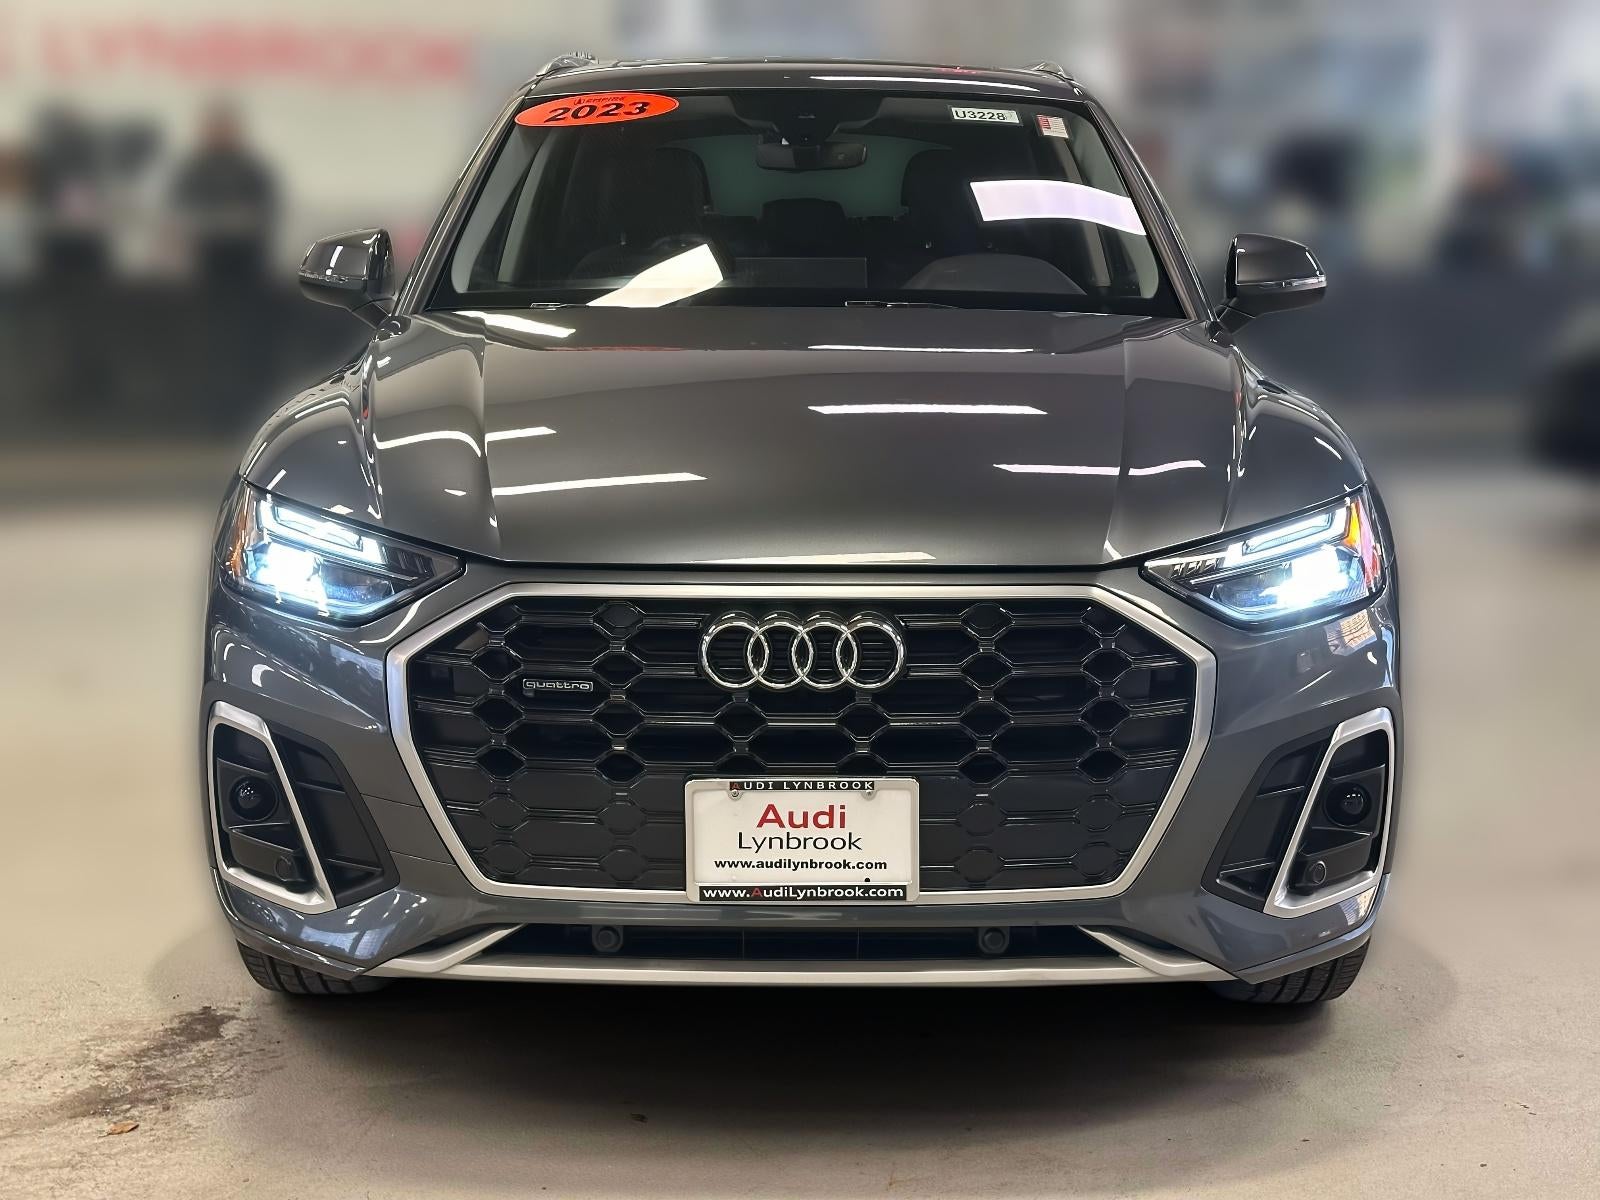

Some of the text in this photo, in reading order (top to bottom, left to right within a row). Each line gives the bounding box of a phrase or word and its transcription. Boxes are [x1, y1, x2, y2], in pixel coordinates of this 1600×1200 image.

[544, 102, 650, 123] 2023
[955, 110, 1006, 121] U3228
[526, 681, 590, 690] quattro
[732, 781, 873, 790] AUDI LYNBROOK
[757, 804, 846, 829] Audi
[738, 832, 862, 854] Lynbrook
[714, 858, 888, 870] www.audilynbrook.com
[703, 886, 904, 900] www.AudiLynbrook.com
